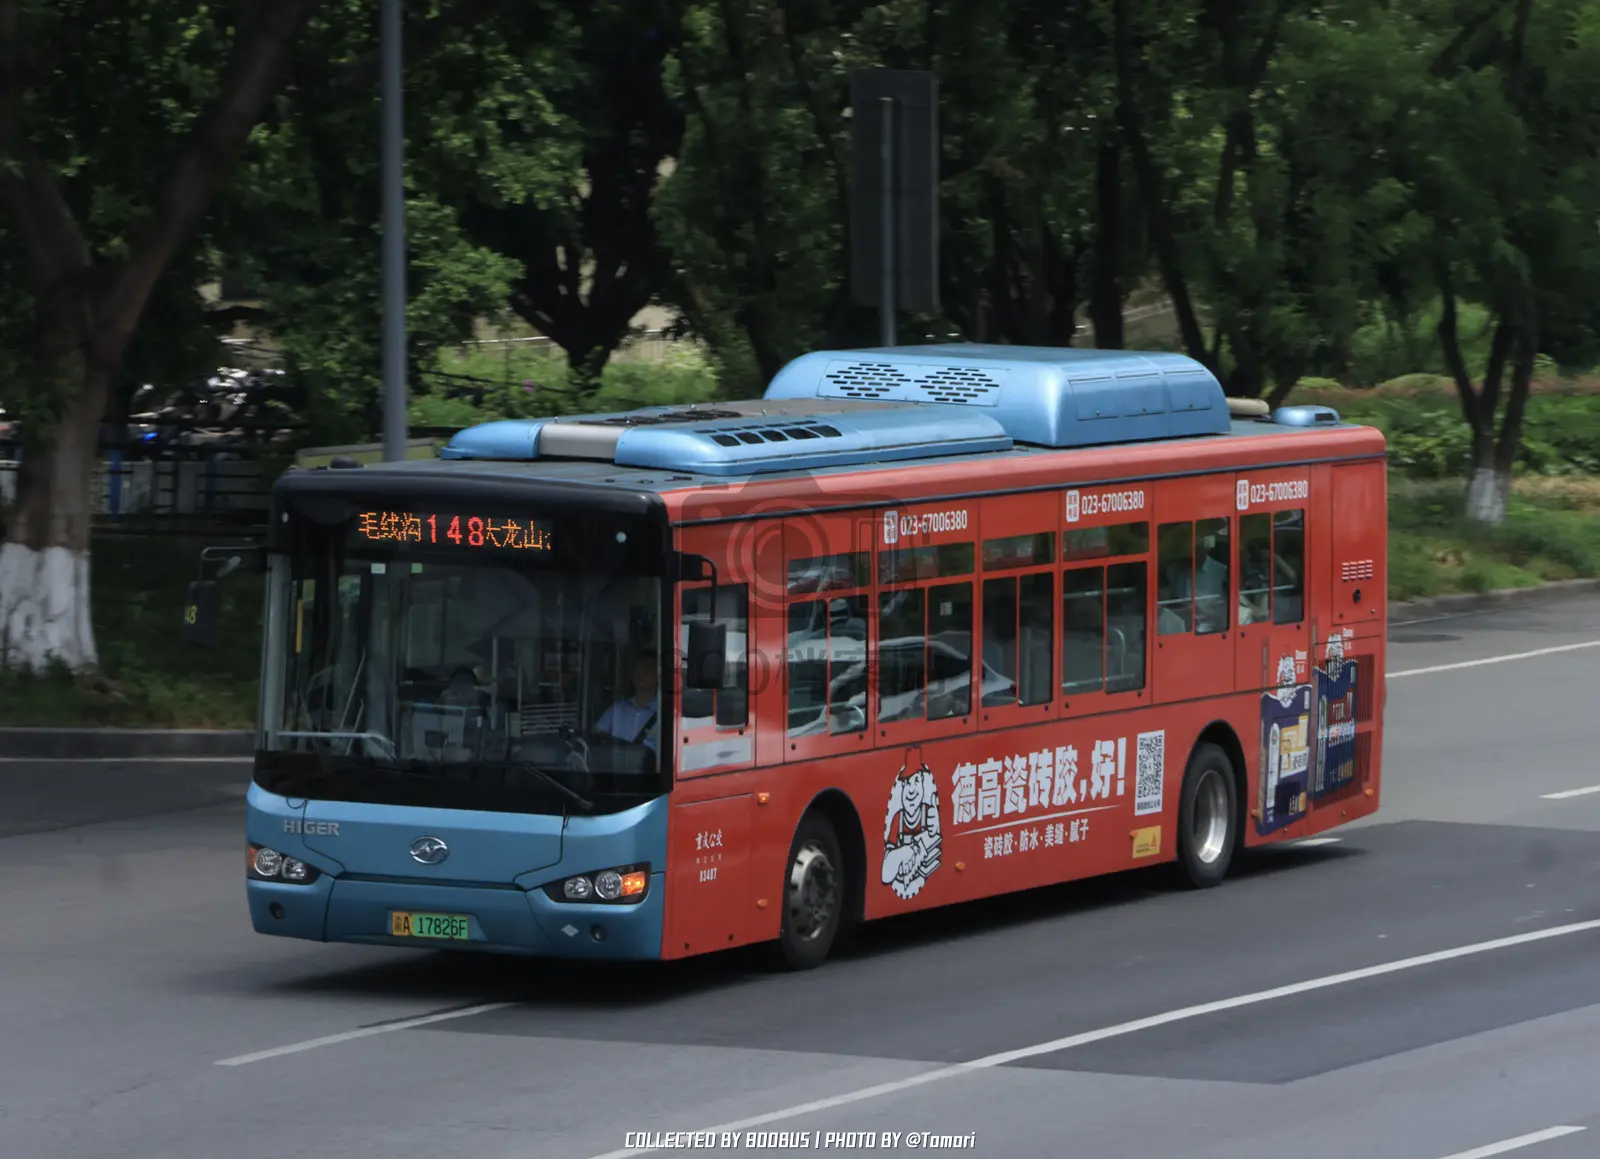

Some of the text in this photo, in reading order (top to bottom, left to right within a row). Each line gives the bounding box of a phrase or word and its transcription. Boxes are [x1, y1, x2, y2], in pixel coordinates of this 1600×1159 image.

[1082, 490, 1144, 515] 023-67006380
[1250, 480, 1308, 503] 023-67006380
[358, 511, 422, 542] 毛线沟
[427, 514, 485, 546] 148
[900, 509, 967, 536] 023-67006380
[283, 820, 341, 836] HIGER
[417, 917, 467, 938] 17826F
